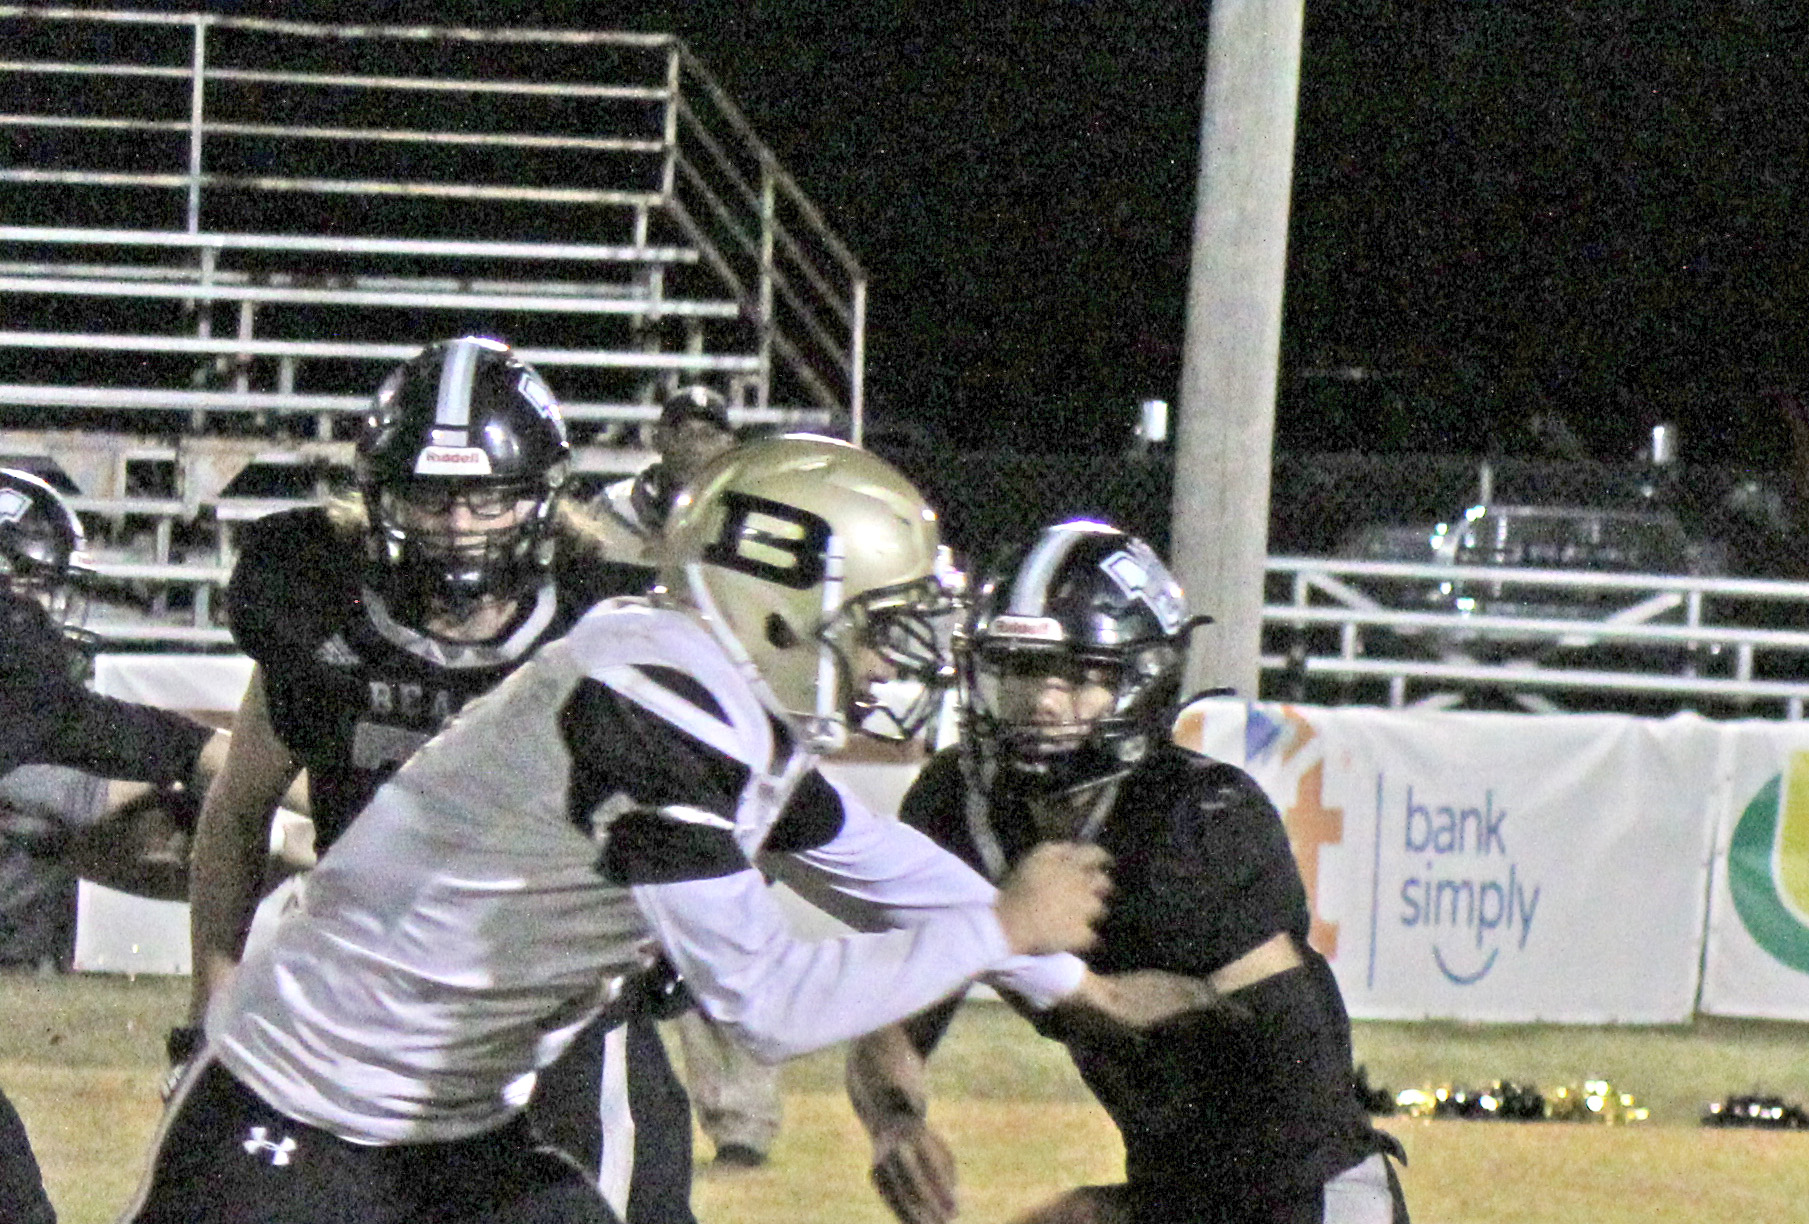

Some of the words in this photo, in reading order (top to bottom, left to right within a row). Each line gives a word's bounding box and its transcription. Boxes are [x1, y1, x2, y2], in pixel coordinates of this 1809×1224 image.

[703, 490, 832, 588] B
[1406, 784, 1507, 855] bank
[1400, 864, 1541, 951] simply
